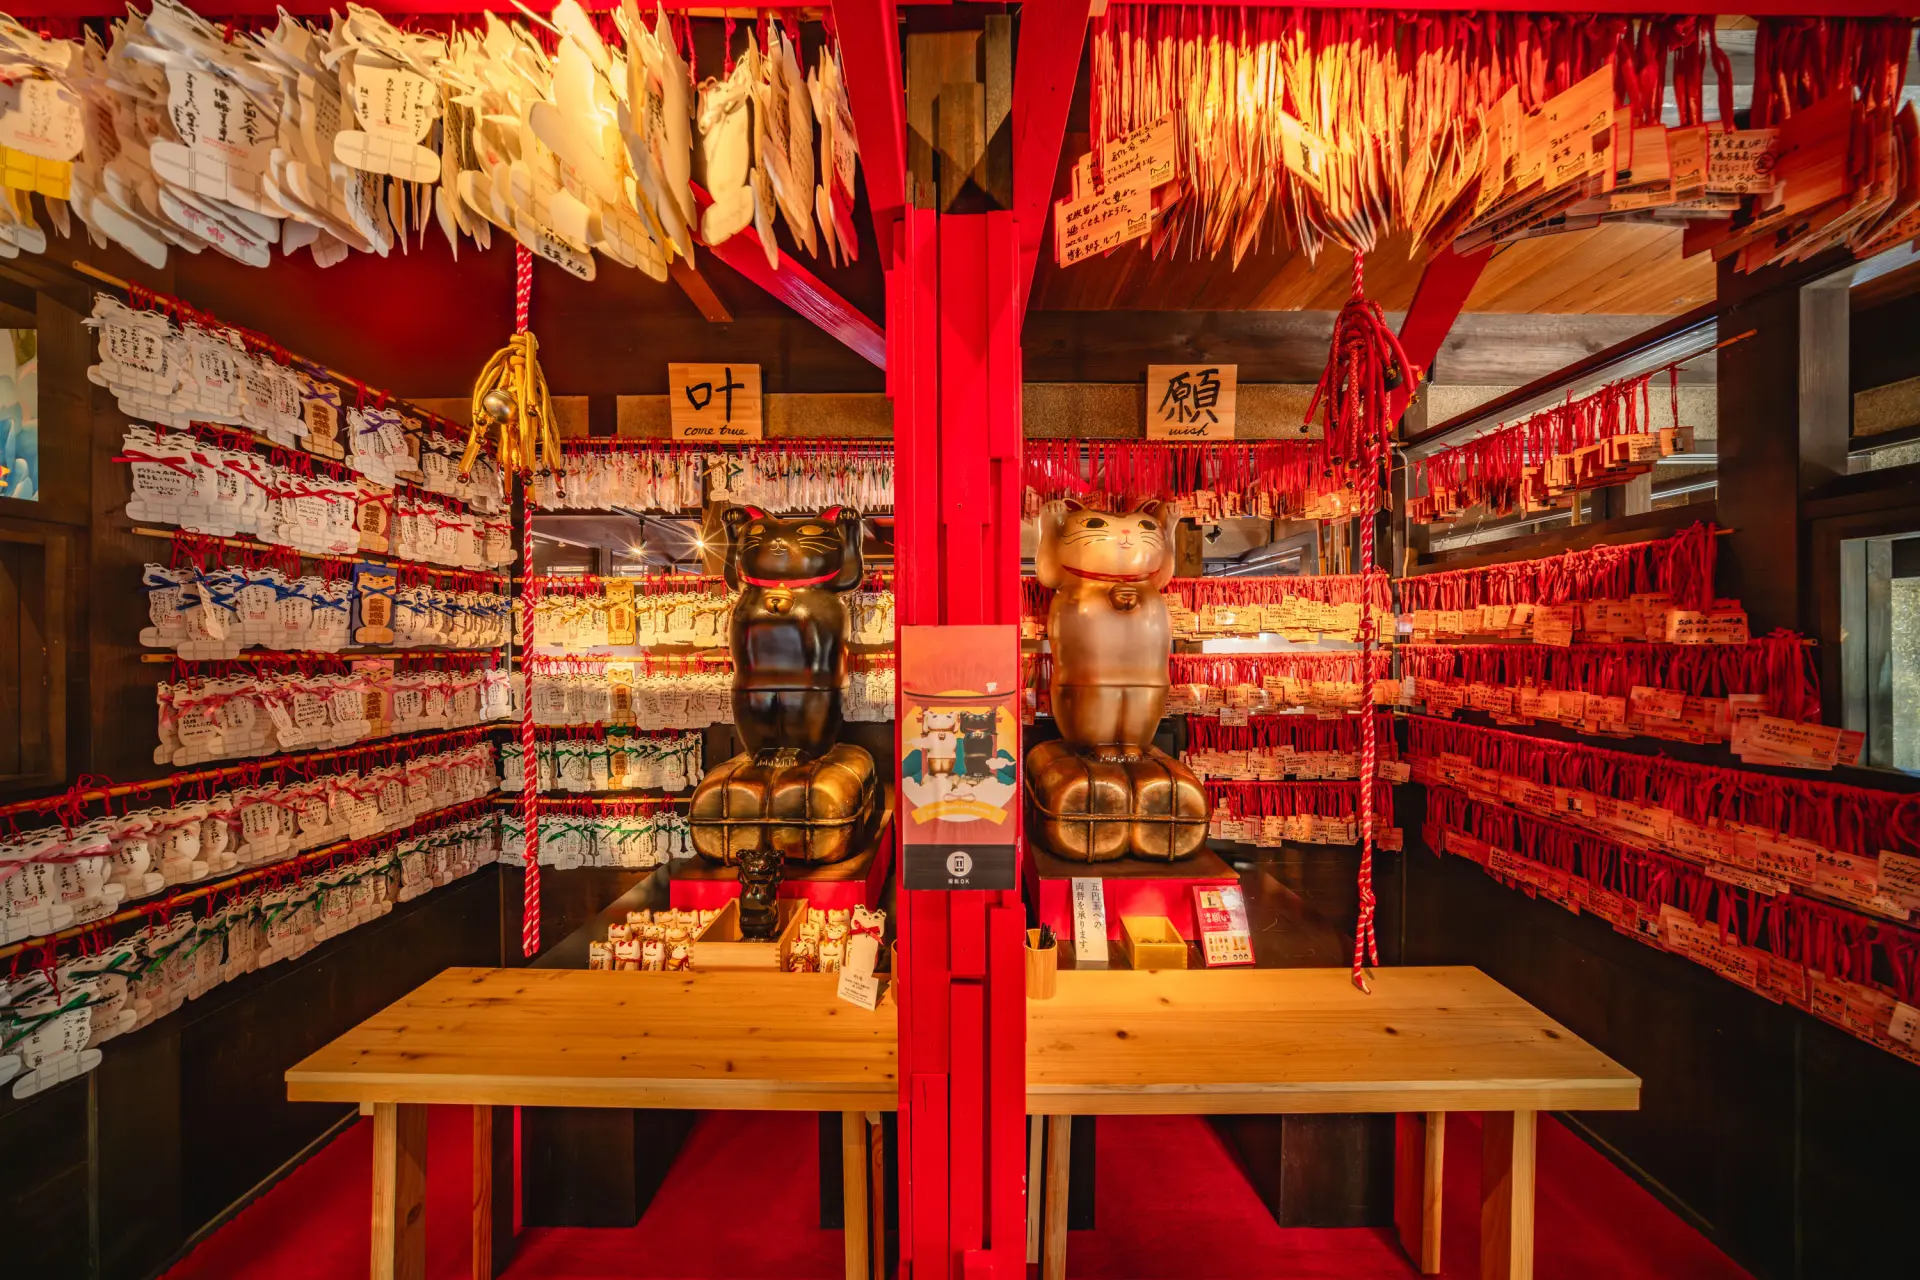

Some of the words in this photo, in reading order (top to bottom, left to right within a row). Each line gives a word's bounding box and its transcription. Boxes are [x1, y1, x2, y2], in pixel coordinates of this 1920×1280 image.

[686, 367, 745, 423] 叶
[1158, 368, 1221, 423] 願
[684, 427, 715, 436] come
[719, 425, 748, 435] true
[1168, 422, 1209, 436] wish
[1075, 882, 1089, 953] 両替を承ります。
[1091, 882, 1102, 930] 五円玉への
